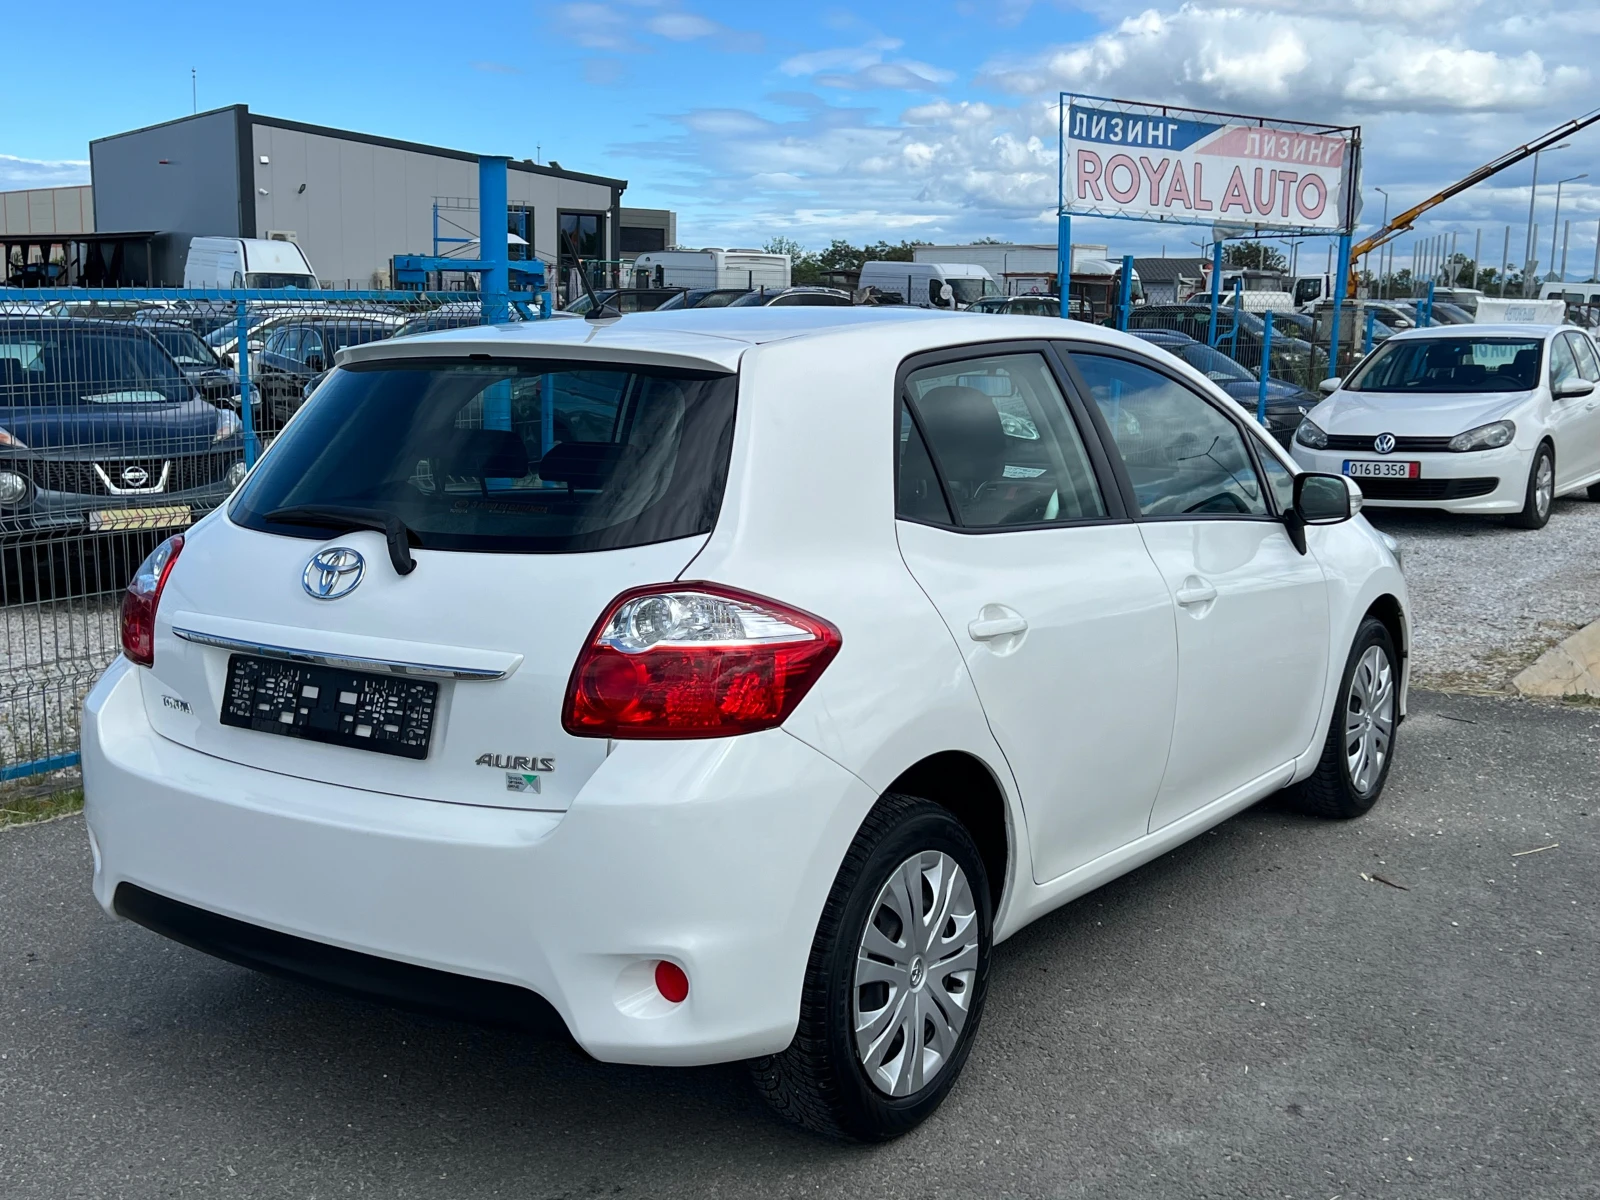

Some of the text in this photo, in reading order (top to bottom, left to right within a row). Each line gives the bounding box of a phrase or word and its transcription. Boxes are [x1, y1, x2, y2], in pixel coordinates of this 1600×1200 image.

[1073, 112, 1178, 147] ЛИЗИНГ
[1243, 133, 1340, 165] ЛИЗИНГ
[1077, 149, 1328, 220] ROYAL AUTO
[1350, 463, 1371, 475] 016
[1383, 464, 1405, 476] 358
[475, 753, 555, 771] AURIS
